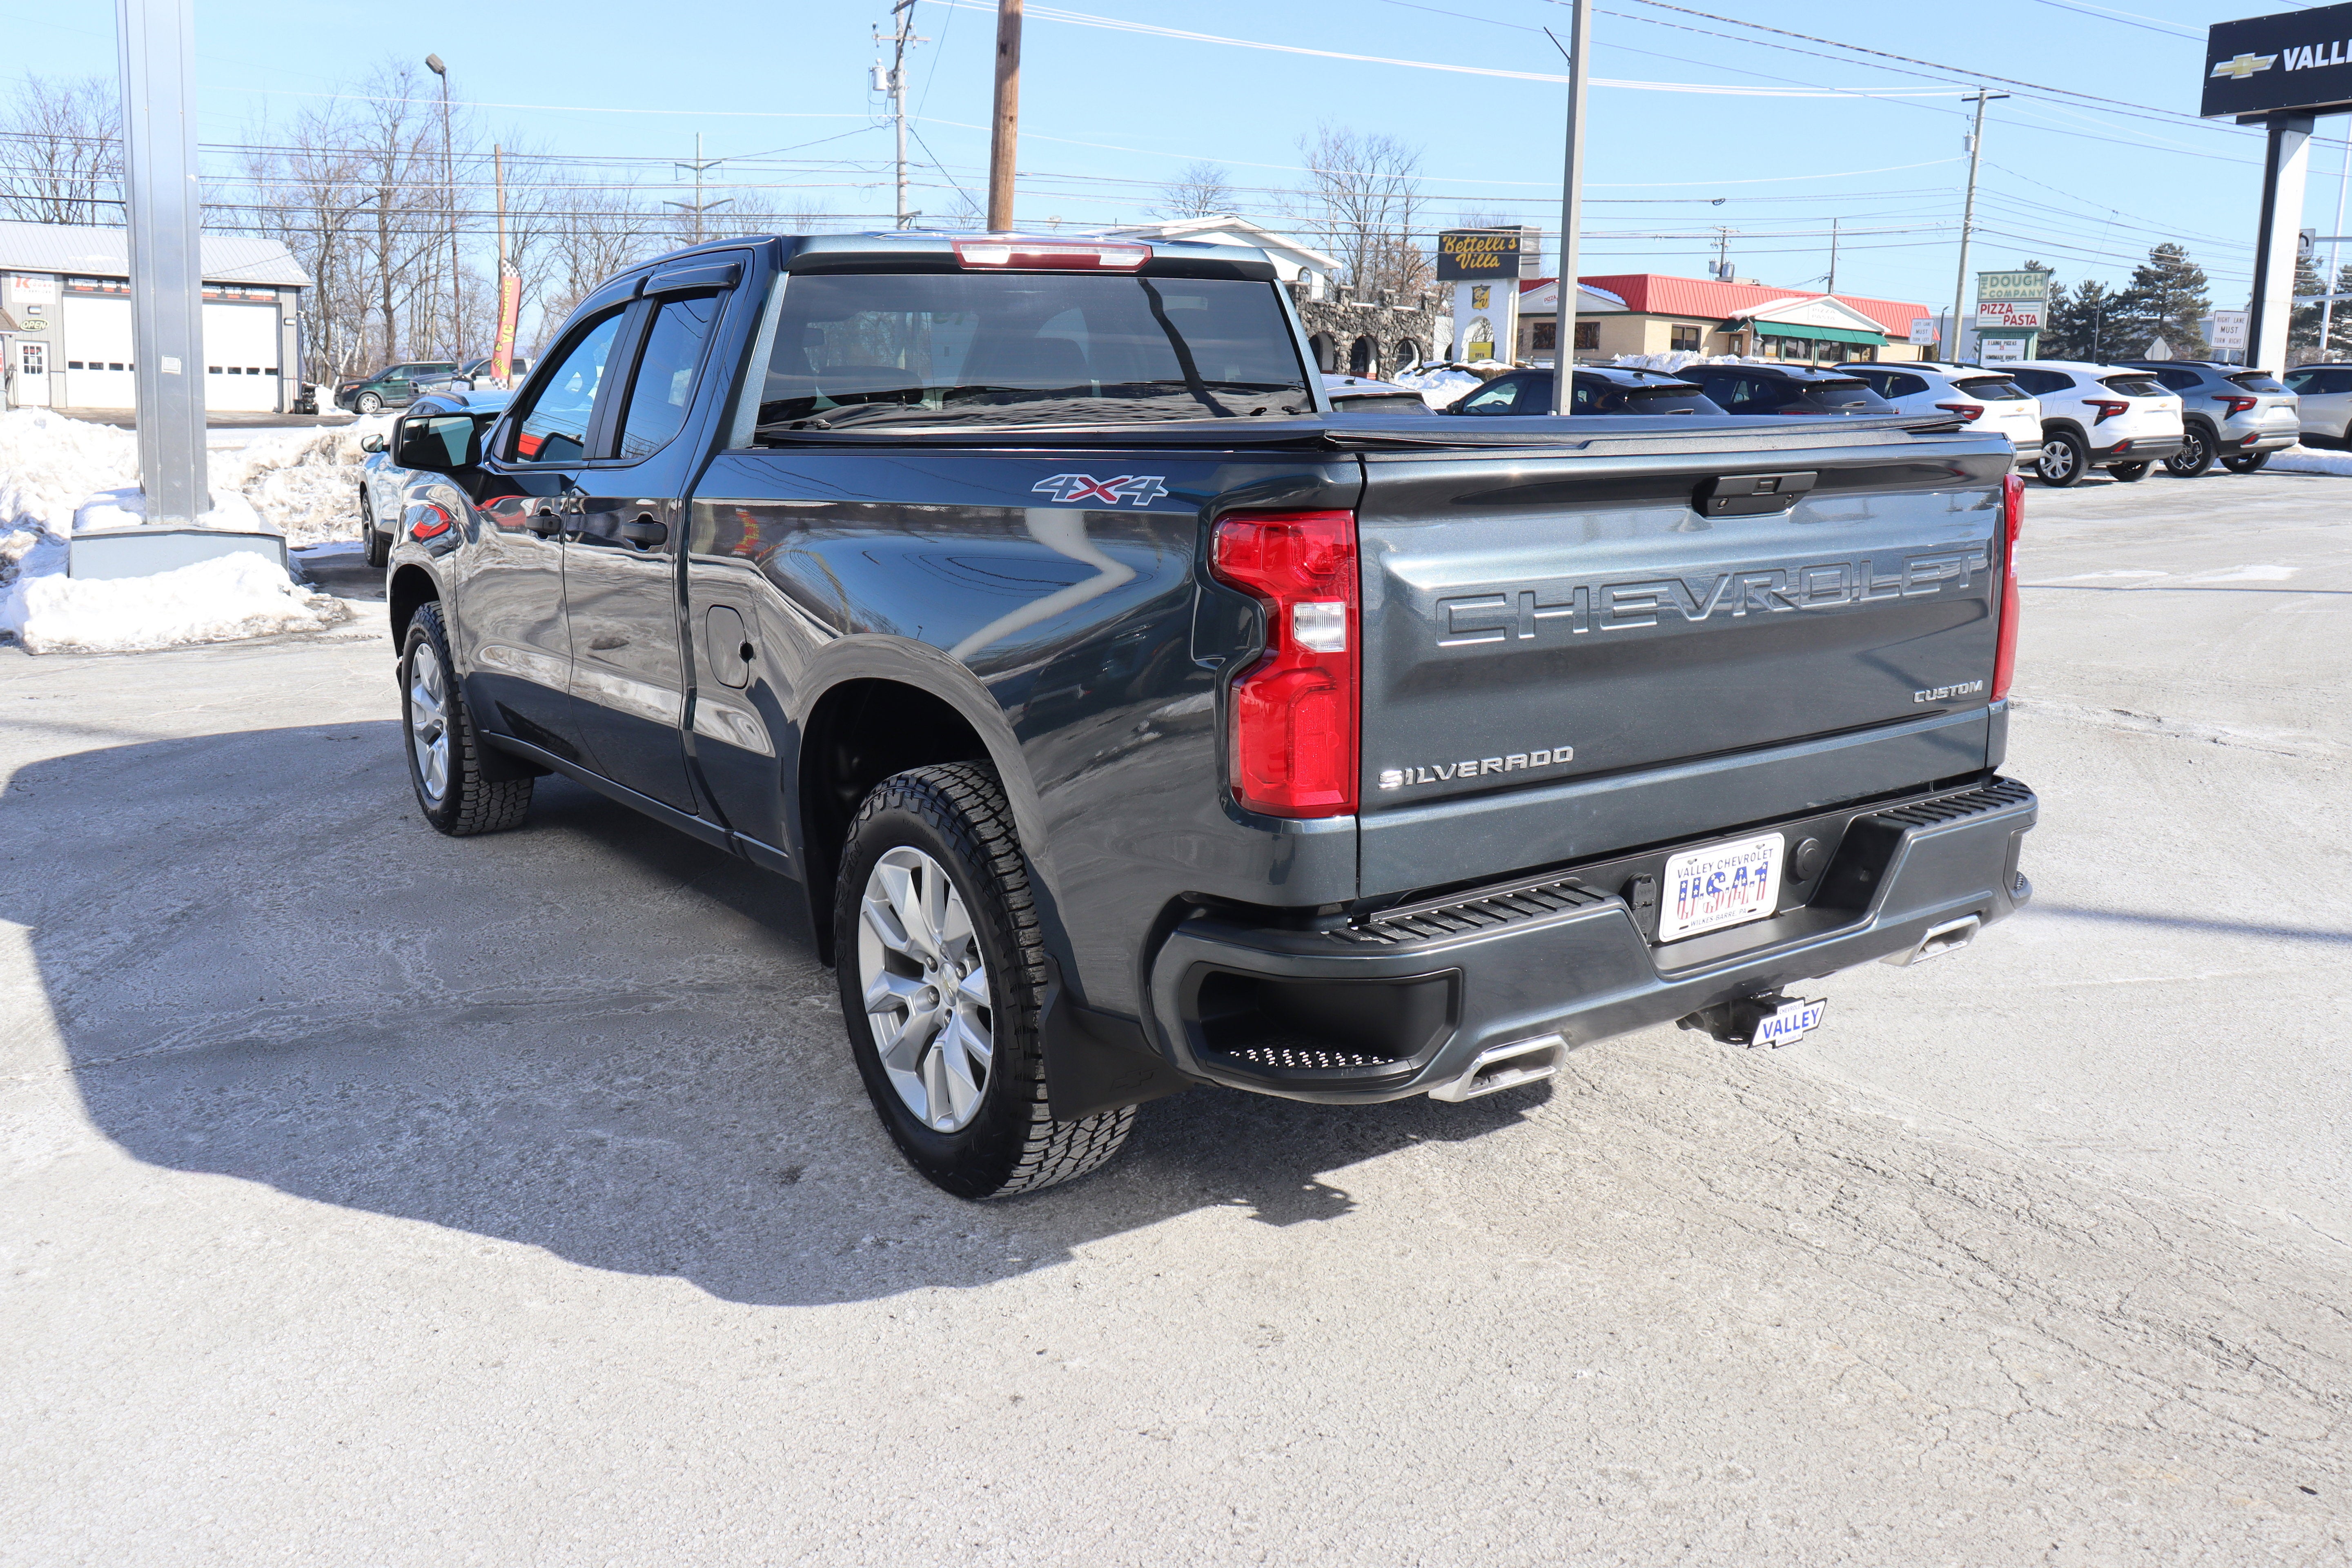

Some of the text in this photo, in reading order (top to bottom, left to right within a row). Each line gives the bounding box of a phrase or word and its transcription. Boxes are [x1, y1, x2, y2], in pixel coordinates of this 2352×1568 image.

[1455, 253, 1501, 270] Villa
[1989, 274, 2045, 288] DOUGH
[1989, 289, 2043, 298] COMPANY
[1980, 303, 2013, 314] PIZZA
[22, 321, 47, 329] OPEN
[2003, 314, 2037, 325] PASTA
[1436, 547, 1984, 647] CHEVROLET
[1913, 679, 1983, 704] CUSTOM
[1379, 745, 1574, 789] SILVERADO
[1677, 848, 1774, 879] VALLEY CHEVROLET
[1779, 1003, 1803, 1014] CHEVROLET
[1763, 1007, 1820, 1039] VALLEY
